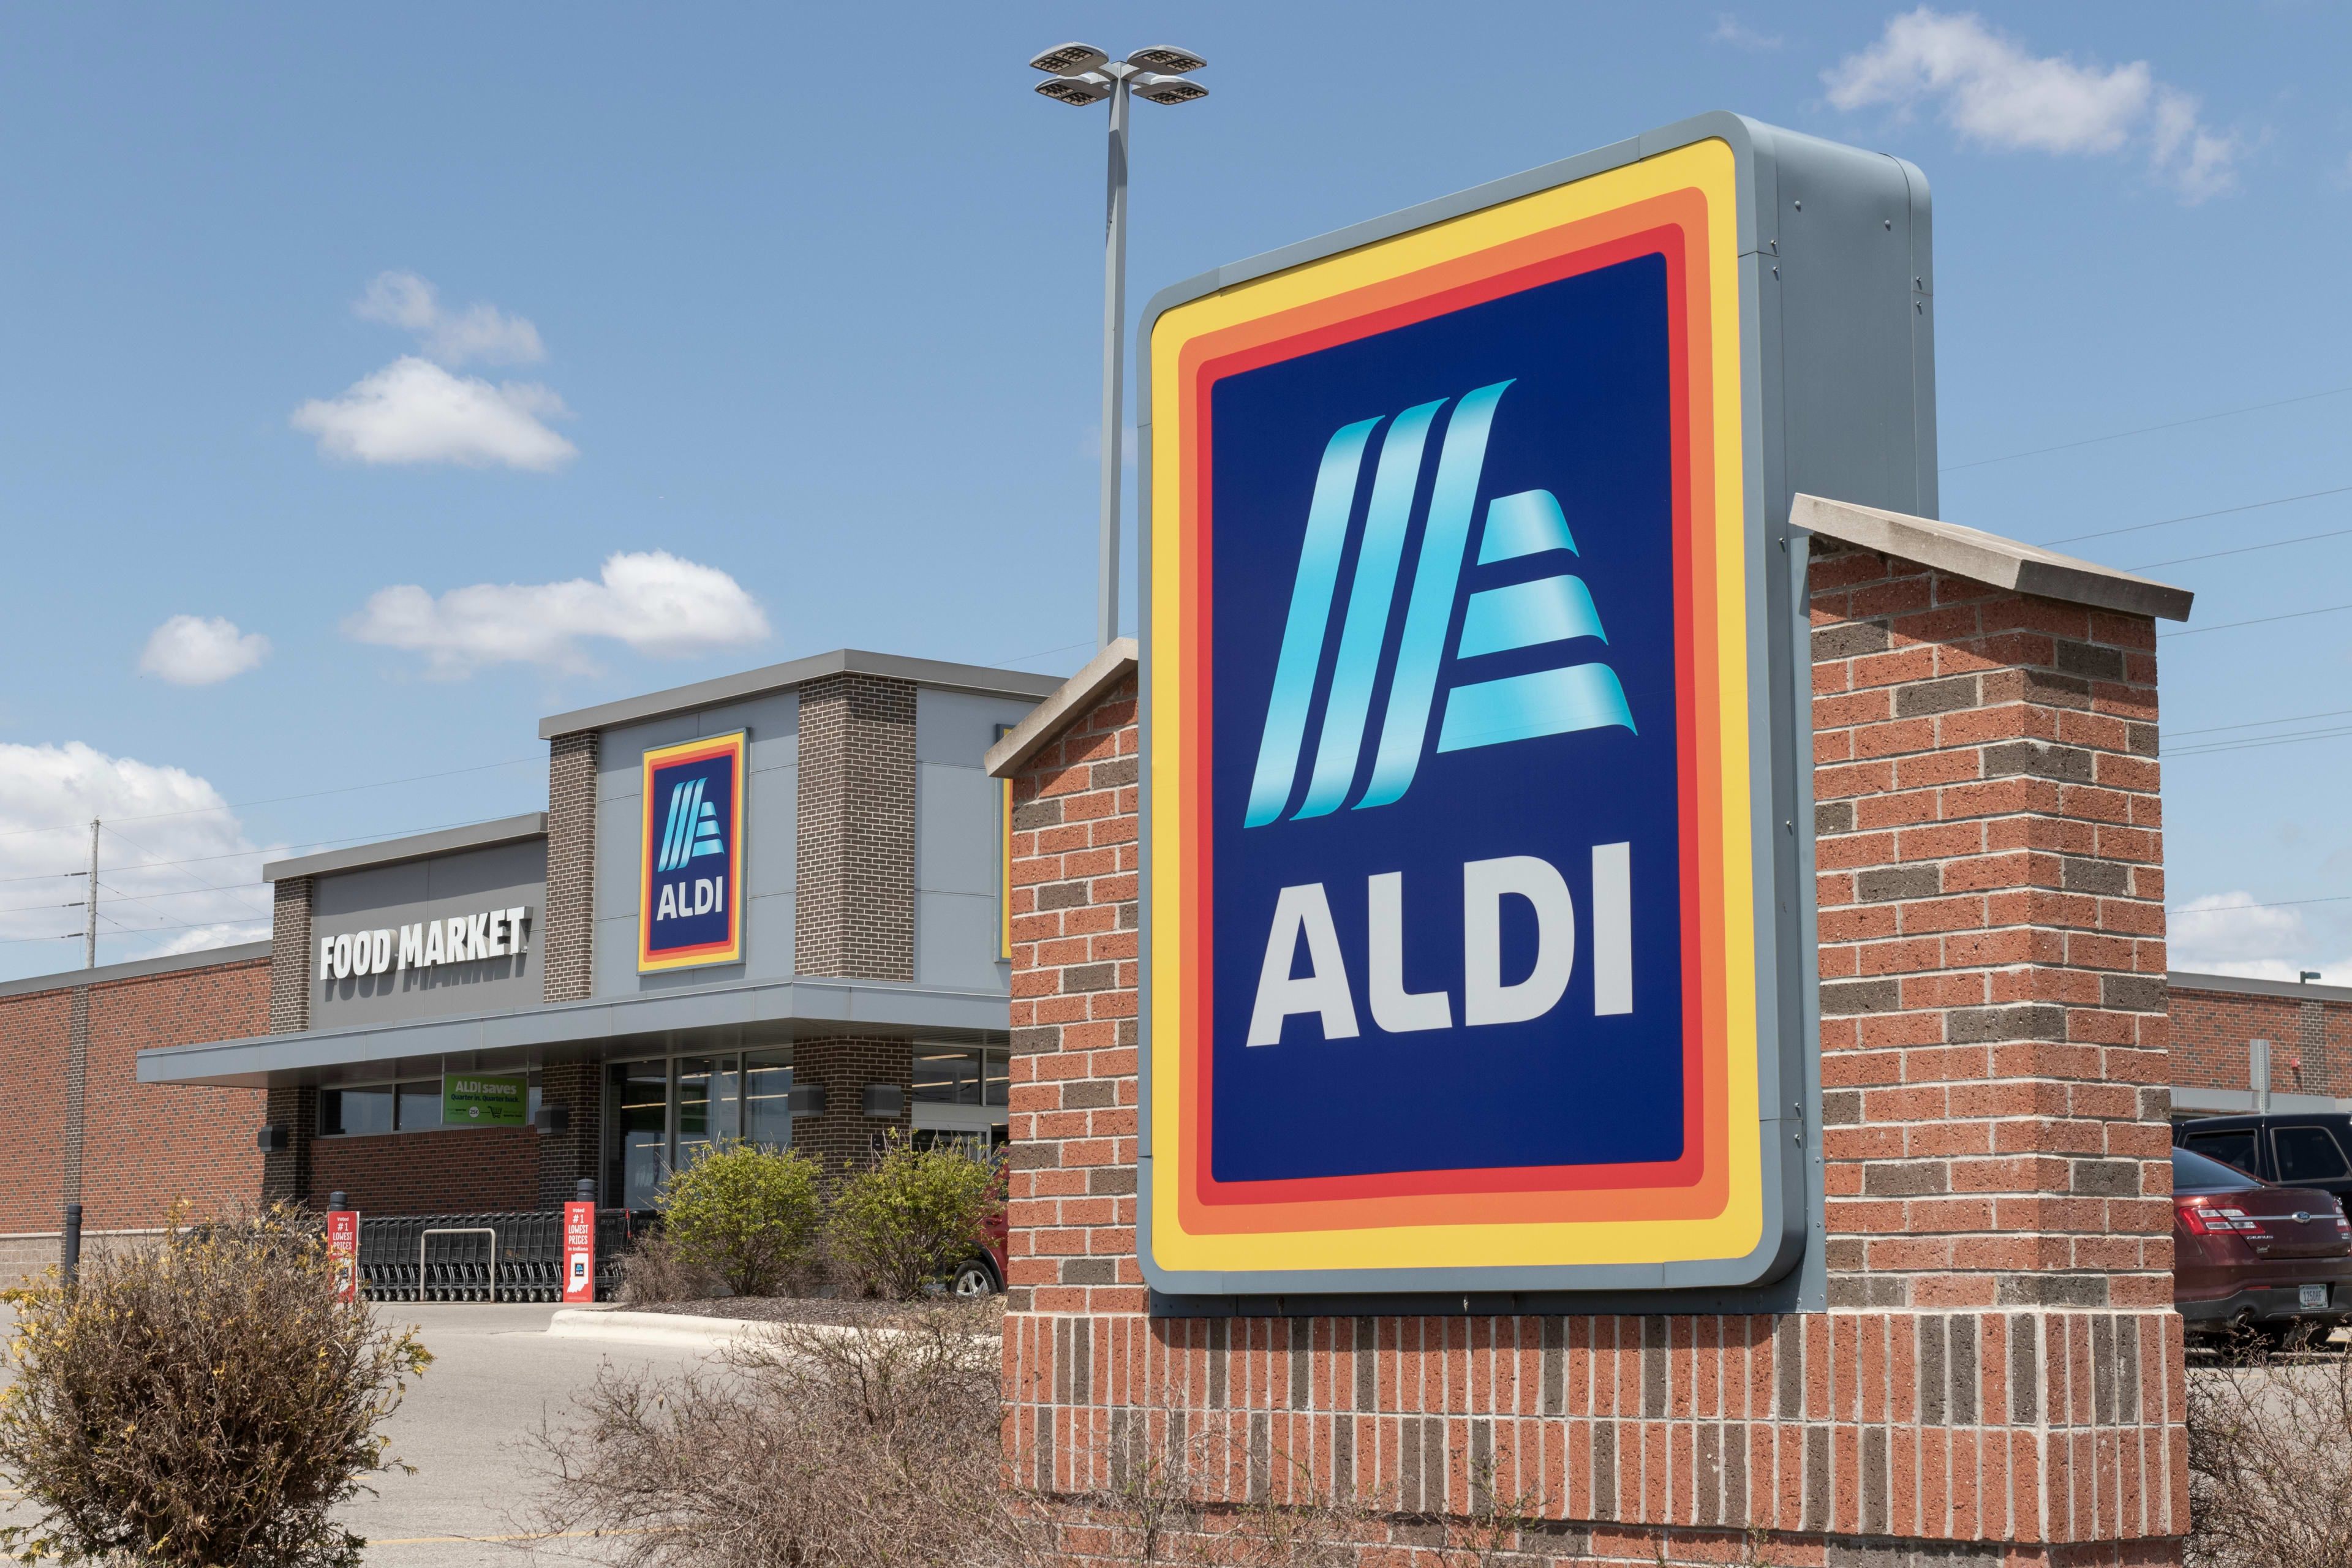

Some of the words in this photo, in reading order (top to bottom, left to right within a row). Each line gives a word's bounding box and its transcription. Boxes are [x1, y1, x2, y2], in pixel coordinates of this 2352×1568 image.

[657, 876, 723, 921] ALDI
[320, 929, 392, 981] FOOD
[398, 906, 527, 971] MARKET
[1246, 842, 1633, 1047] ALDI
[455, 1080, 481, 1093] ALDI
[483, 1084, 517, 1095] saves
[568, 1224, 589, 1234] LOWEST
[333, 1232, 353, 1241] LOWEST
[568, 1235, 588, 1245] PRICES
[333, 1242, 352, 1250] PRICES
